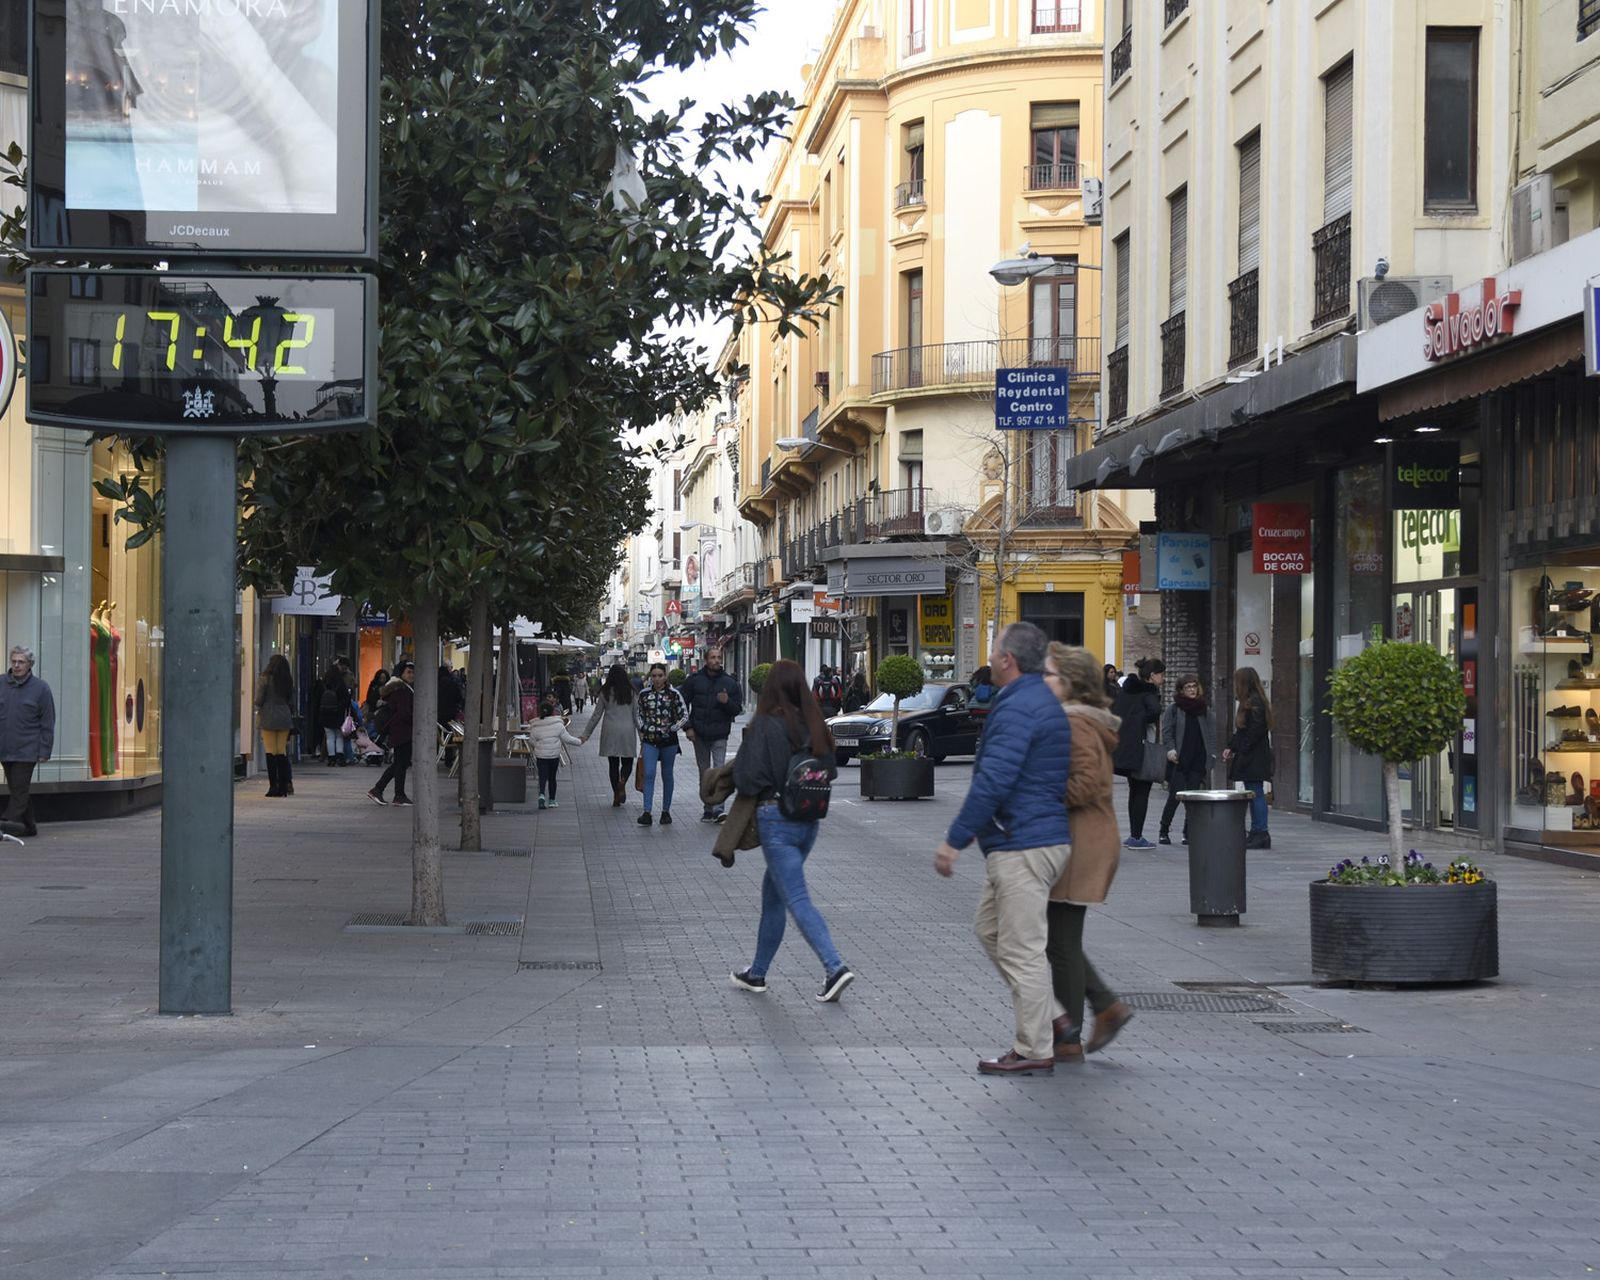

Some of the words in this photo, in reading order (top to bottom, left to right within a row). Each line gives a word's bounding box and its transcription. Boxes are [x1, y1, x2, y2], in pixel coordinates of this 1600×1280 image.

[114, 0, 287, 17] ENAMORA
[135, 158, 261, 175] HAMMAM
[169, 225, 230, 237] JCDecaux
[1423, 278, 1521, 362] Salvador
[112, 311, 315, 375] 17:42
[1007, 372, 1055, 383] Clínica
[998, 385, 1065, 399] Reydental
[1010, 402, 1053, 412] Centro
[998, 416, 1015, 426] TLF.
[1016, 416, 1032, 426] 957
[1034, 416, 1044, 425] 47
[1047, 416, 1055, 425] 14
[1058, 416, 1065, 425] 11
[1397, 462, 1450, 489] telecor
[1258, 527, 1305, 539] Cruzcampo
[1401, 510, 1451, 565] telecor
[1263, 553, 1304, 561] BOCATA
[1264, 563, 1278, 571] DE
[1280, 563, 1304, 571] ORO
[866, 575, 901, 584] SECTOR
[904, 573, 926, 582] ORO
[925, 604, 947, 617] ORO
[812, 621, 838, 633] TORIL
